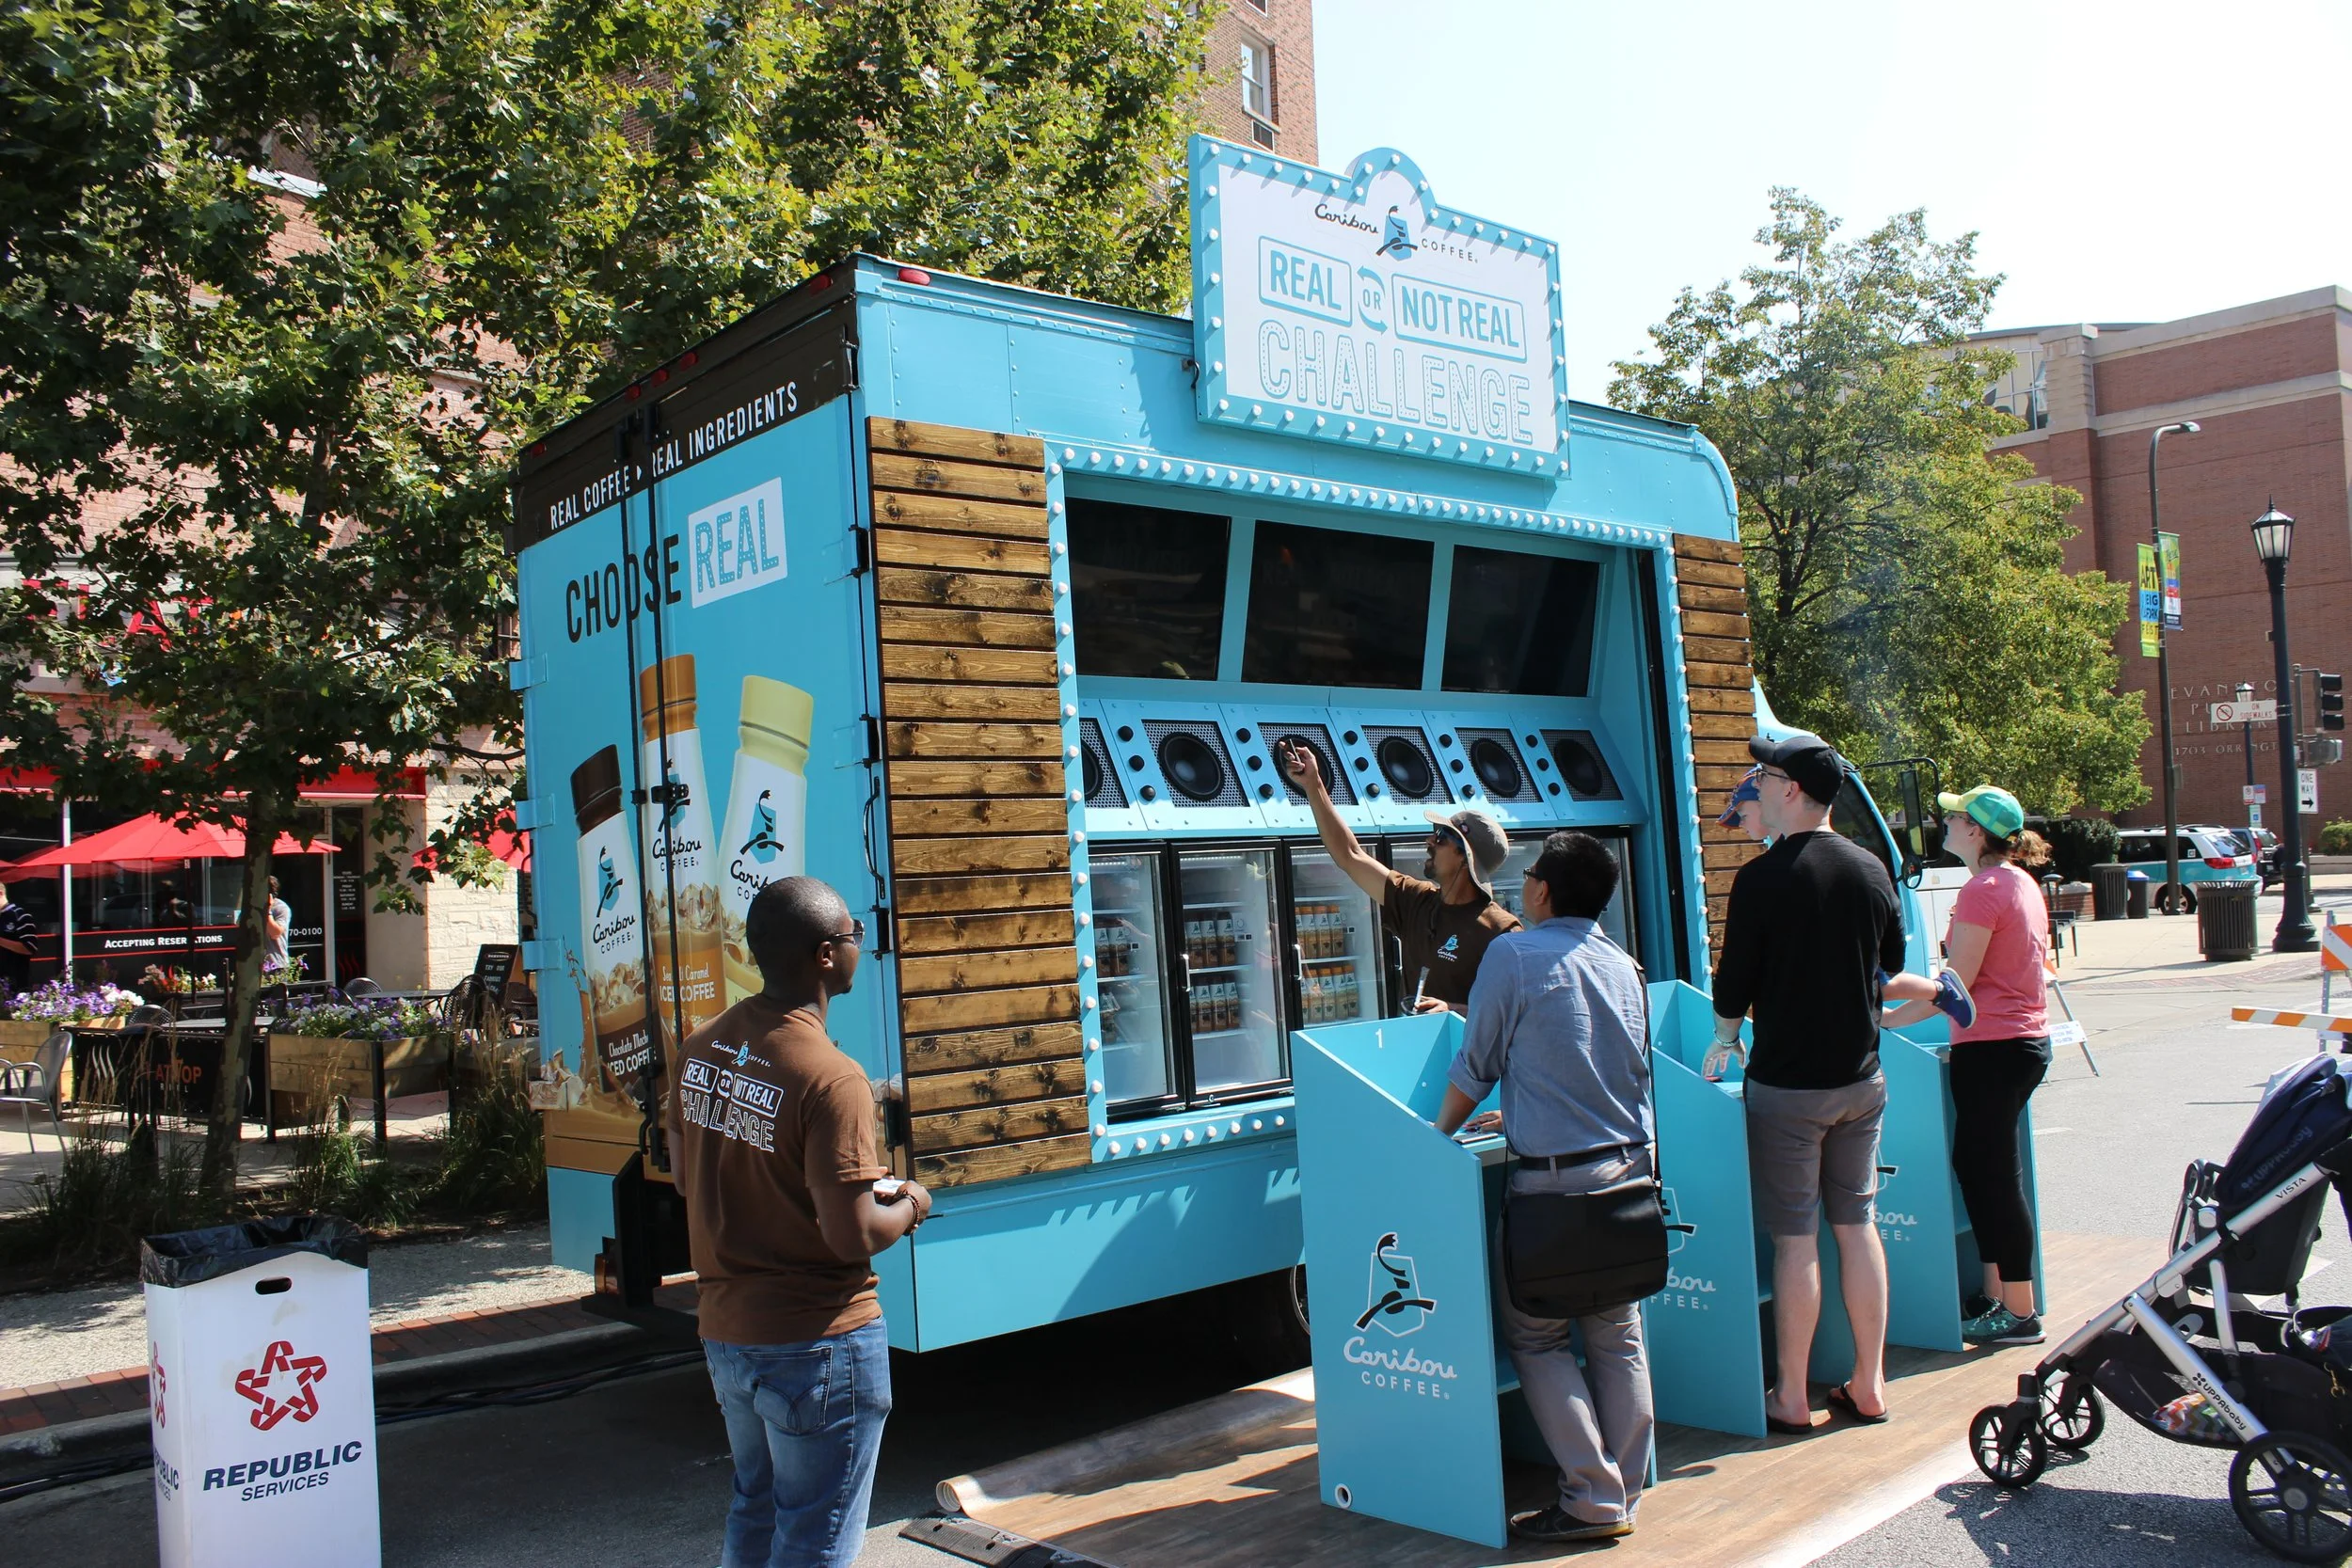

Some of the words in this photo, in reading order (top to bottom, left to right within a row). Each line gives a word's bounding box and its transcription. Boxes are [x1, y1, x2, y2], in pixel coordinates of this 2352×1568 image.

[1314, 203, 1379, 234] Caribou
[1422, 238, 1474, 262] COFFEE
[1270, 249, 1342, 311] REAL
[1362, 287, 1382, 312] OR
[1402, 285, 1454, 336] NOT
[1460, 296, 1520, 349] REAL
[1258, 320, 1534, 446] CHALLENGE
[550, 495, 580, 531] REAL
[583, 466, 630, 513] COFFEE
[689, 381, 798, 460] INGREDIENTS
[565, 534, 681, 643] CHOOSE
[695, 499, 780, 594] REAL
[2240, 710, 2273, 721] SIDEWALKS
[2175, 746, 2206, 756] 1703
[2301, 773, 2313, 784] ONE
[2301, 784, 2314, 794] WAY
[652, 836, 702, 859] Caibou
[660, 857, 695, 871] CFFEE
[593, 914, 636, 944] Caribou
[104, 938, 155, 949] ACCEPTING
[158, 935, 223, 945] RESERTIONS
[601, 931, 631, 954] COFFEE
[1438, 949, 1458, 959] Caribou
[685, 961, 709, 981] Caramel
[679, 981, 715, 1003] COFFEE
[609, 1037, 632, 1057] Chocolate
[1375, 1028, 1384, 1049] 1
[711, 1039, 739, 1055] Caribou
[748, 1053, 769, 1067] COFFEE
[684, 1067, 709, 1086] REAL
[720, 1078, 731, 1088] OR
[748, 1084, 774, 1110] REAL
[2275, 1177, 2307, 1199] VISTA
[1343, 1336, 1457, 1379] Caribou
[1361, 1370, 1440, 1399] COFFEE
[2202, 1383, 2247, 1431] UPPAbaby
[203, 1441, 362, 1491] REPUBLIC
[241, 1472, 329, 1502] SERVICES
